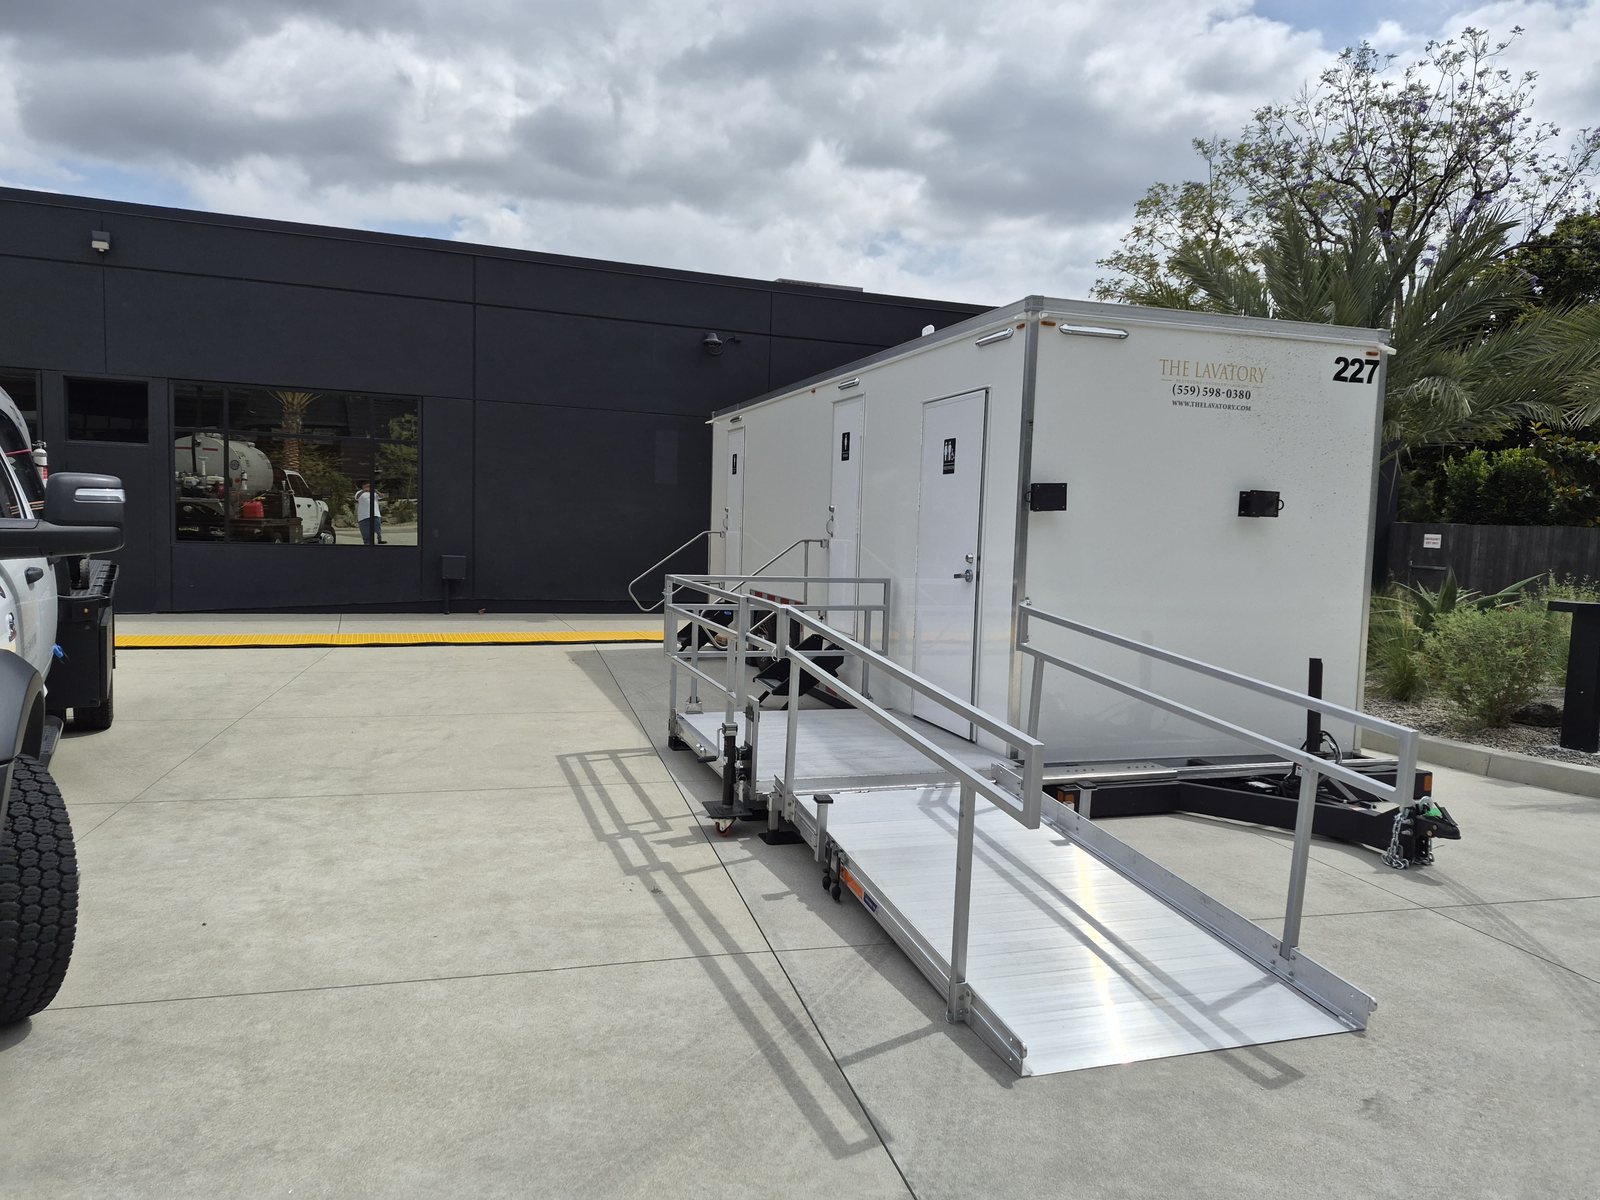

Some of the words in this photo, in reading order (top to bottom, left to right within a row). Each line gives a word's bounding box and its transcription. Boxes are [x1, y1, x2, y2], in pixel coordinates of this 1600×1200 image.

[1160, 359, 1189, 376] THE
[1195, 362, 1267, 383] LAVATORY
[1332, 356, 1380, 384] 227
[1172, 383, 1201, 398] (559)
[1202, 387, 1251, 400] 598-0380
[1172, 400, 1251, 411] WWW.THELAVATORY.COM
